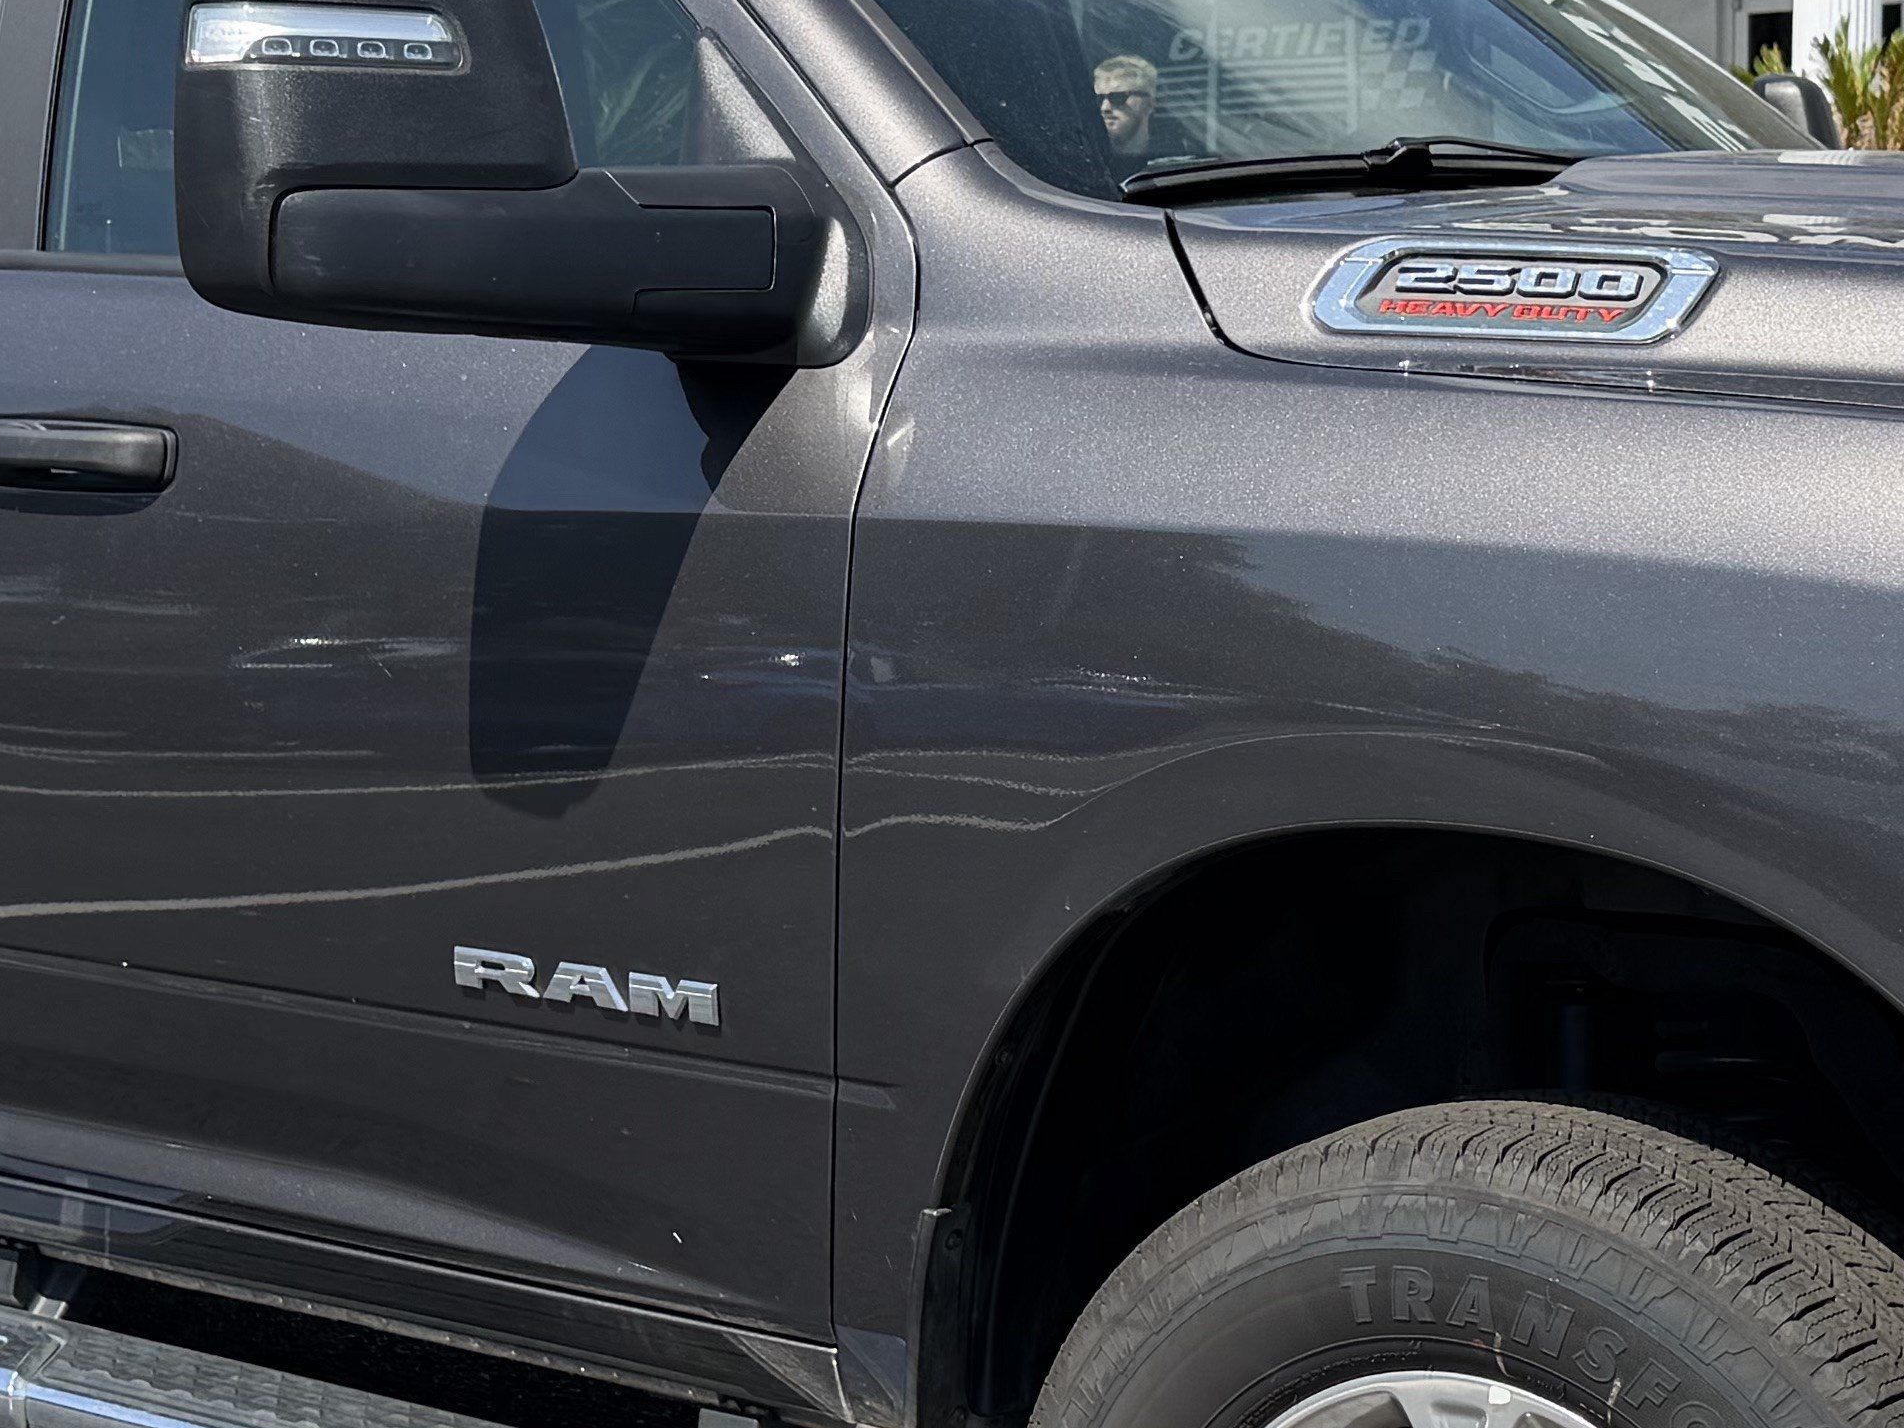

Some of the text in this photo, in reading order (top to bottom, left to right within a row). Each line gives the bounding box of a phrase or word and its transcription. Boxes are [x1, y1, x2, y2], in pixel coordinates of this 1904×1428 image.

[1168, 18, 1432, 62] CERTIFED
[1396, 263, 1644, 301] 2500
[1379, 298, 1624, 324] HEAVY DUTY
[454, 945, 720, 1027] RAM
